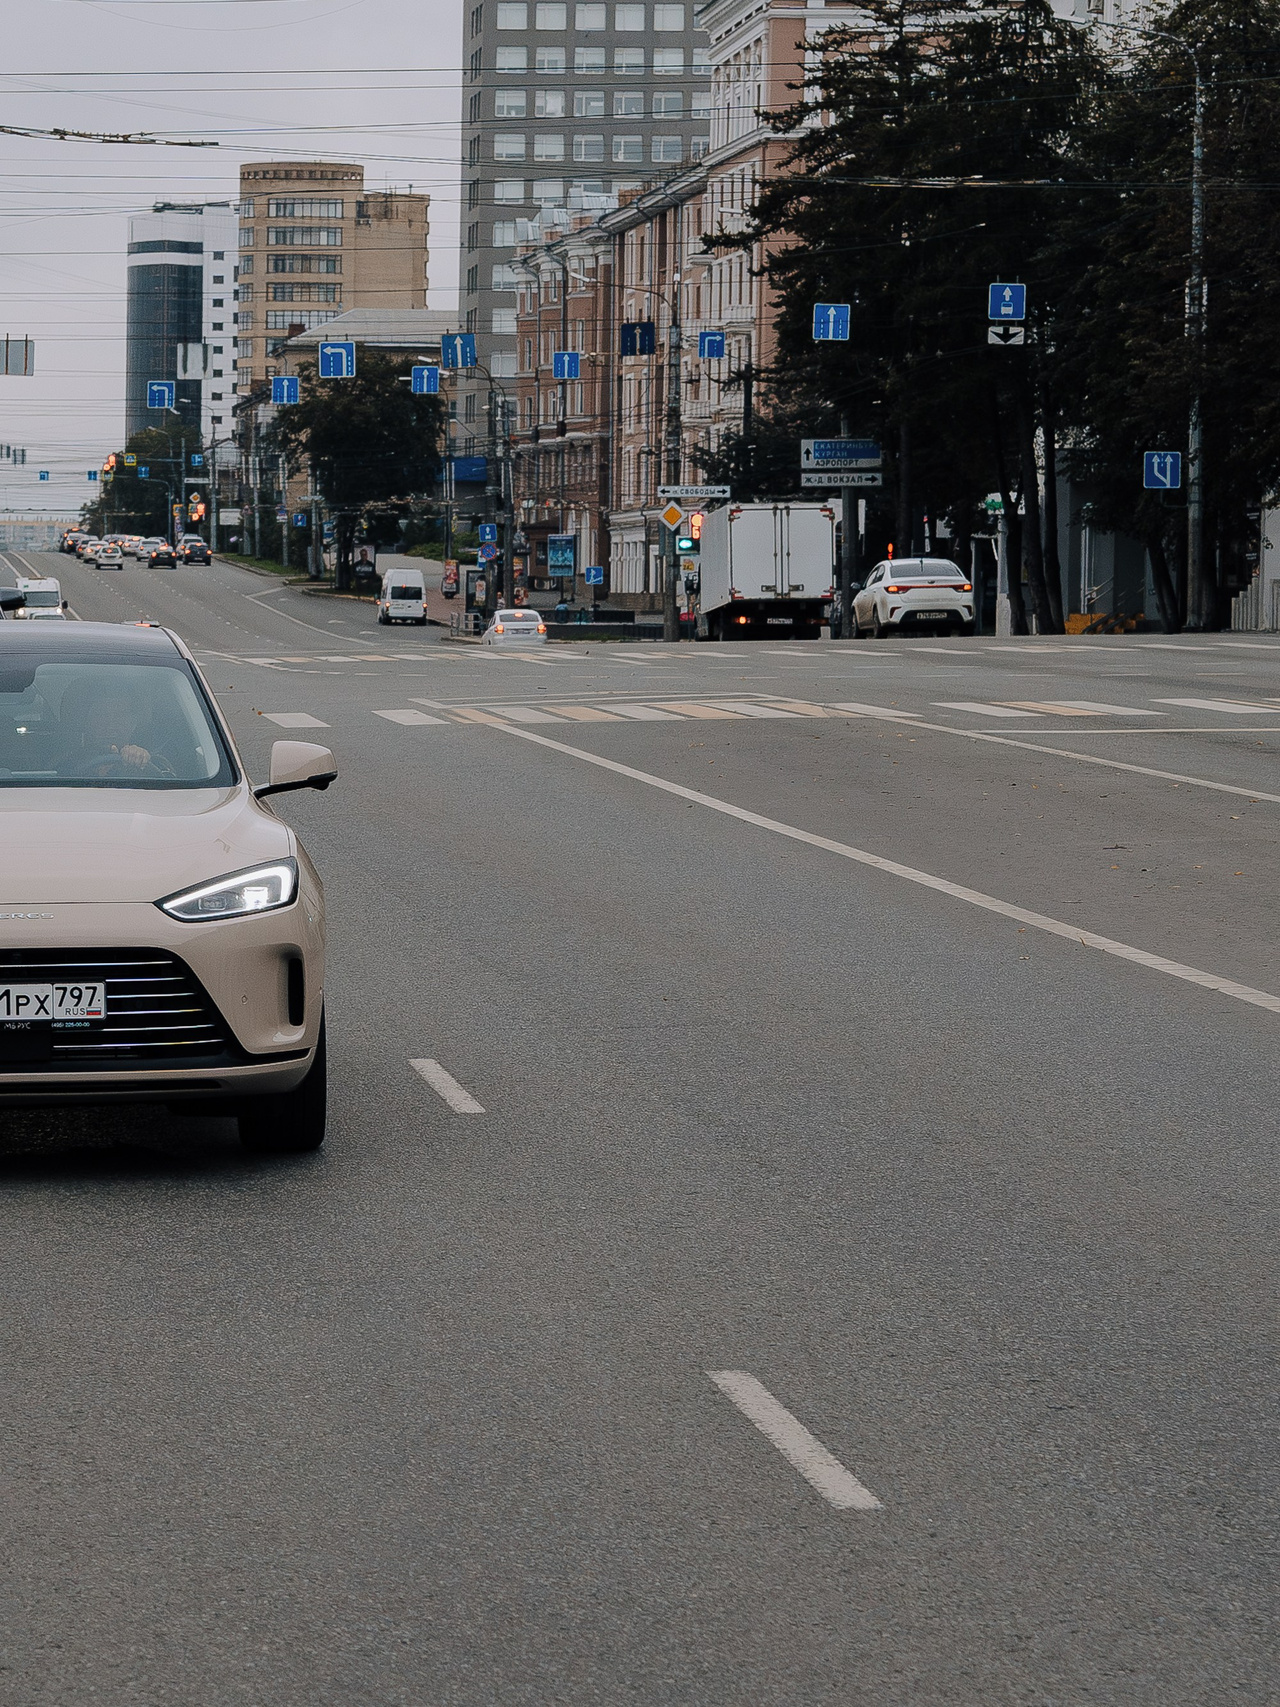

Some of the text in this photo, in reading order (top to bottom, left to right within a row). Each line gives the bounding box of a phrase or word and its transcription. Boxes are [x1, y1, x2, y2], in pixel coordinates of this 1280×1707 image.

[826, 475, 863, 483] ВОКЗАЛ
[680, 488, 716, 496] СВОБОДЫ
[692, 526, 700, 539] 6
[54, 986, 98, 1008] 797
[65, 1007, 86, 1016] RUS
